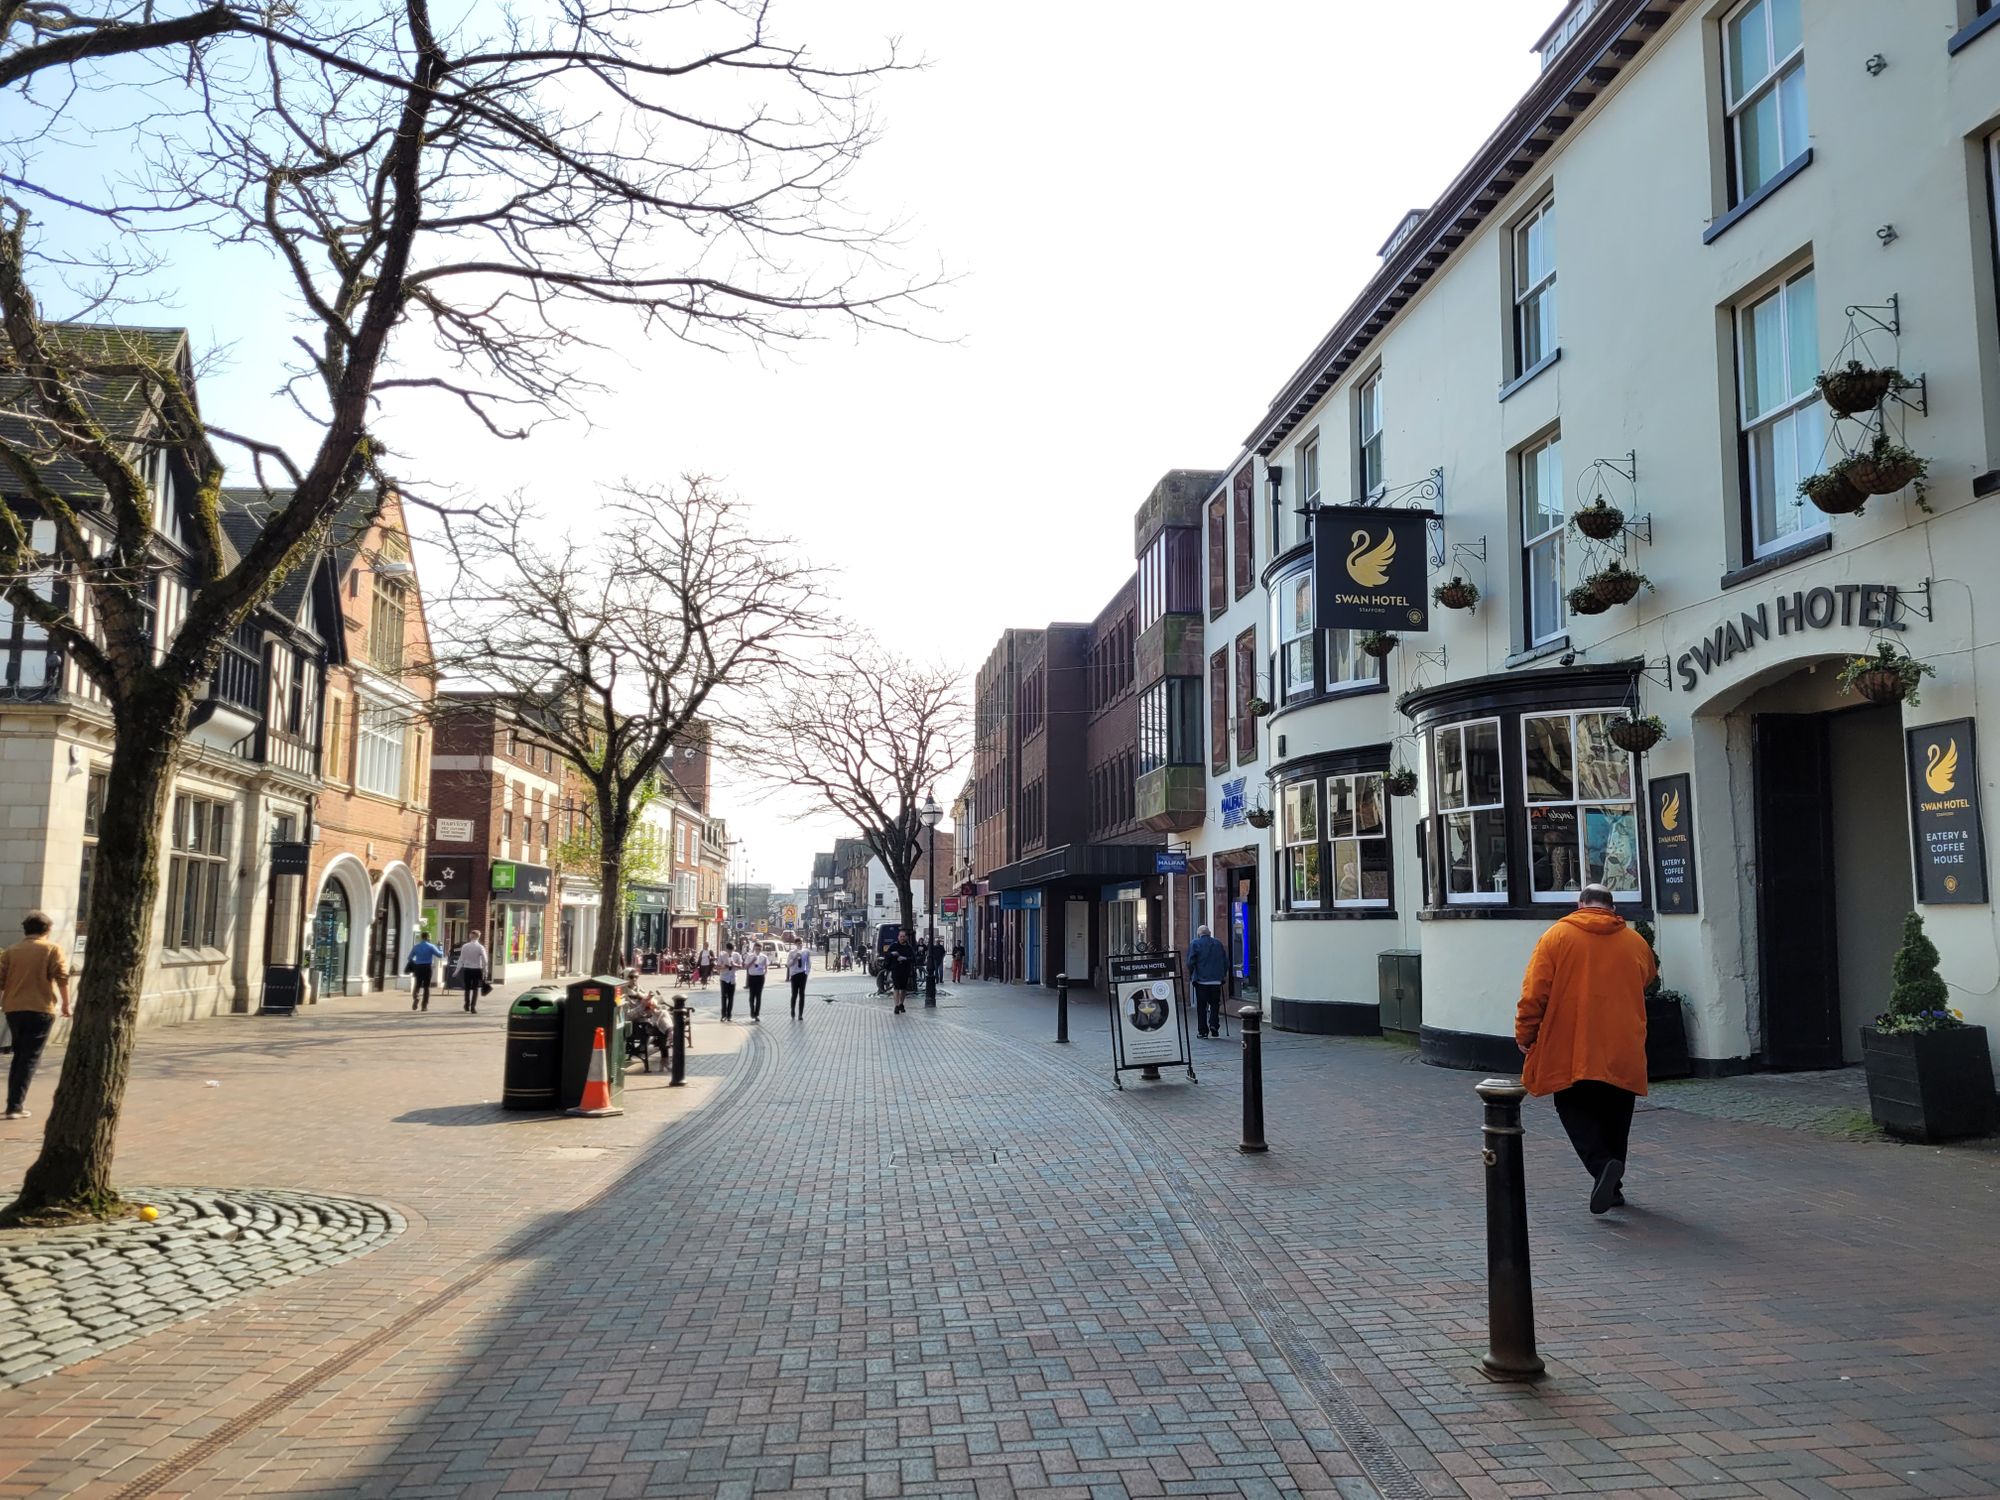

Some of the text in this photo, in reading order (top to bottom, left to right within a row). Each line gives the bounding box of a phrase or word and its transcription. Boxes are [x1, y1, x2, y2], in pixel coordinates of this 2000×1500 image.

[1335, 593, 1410, 606] SWAN HOTEL
[1676, 584, 1906, 692] SWAN HOTEL
[1221, 794, 1244, 814] HALIFAX
[1920, 799, 1970, 812] SWAN HOTEL
[1657, 834, 1687, 844] SWAN HOTEL
[1926, 830, 1968, 842] EATERY &
[1930, 842, 1965, 853] COFFEE
[1661, 858, 1681, 867] EATERY
[1933, 854, 1964, 864] HOUSE
[1664, 867, 1684, 875] COFFEE
[1665, 876, 1684, 884] HOUSE
